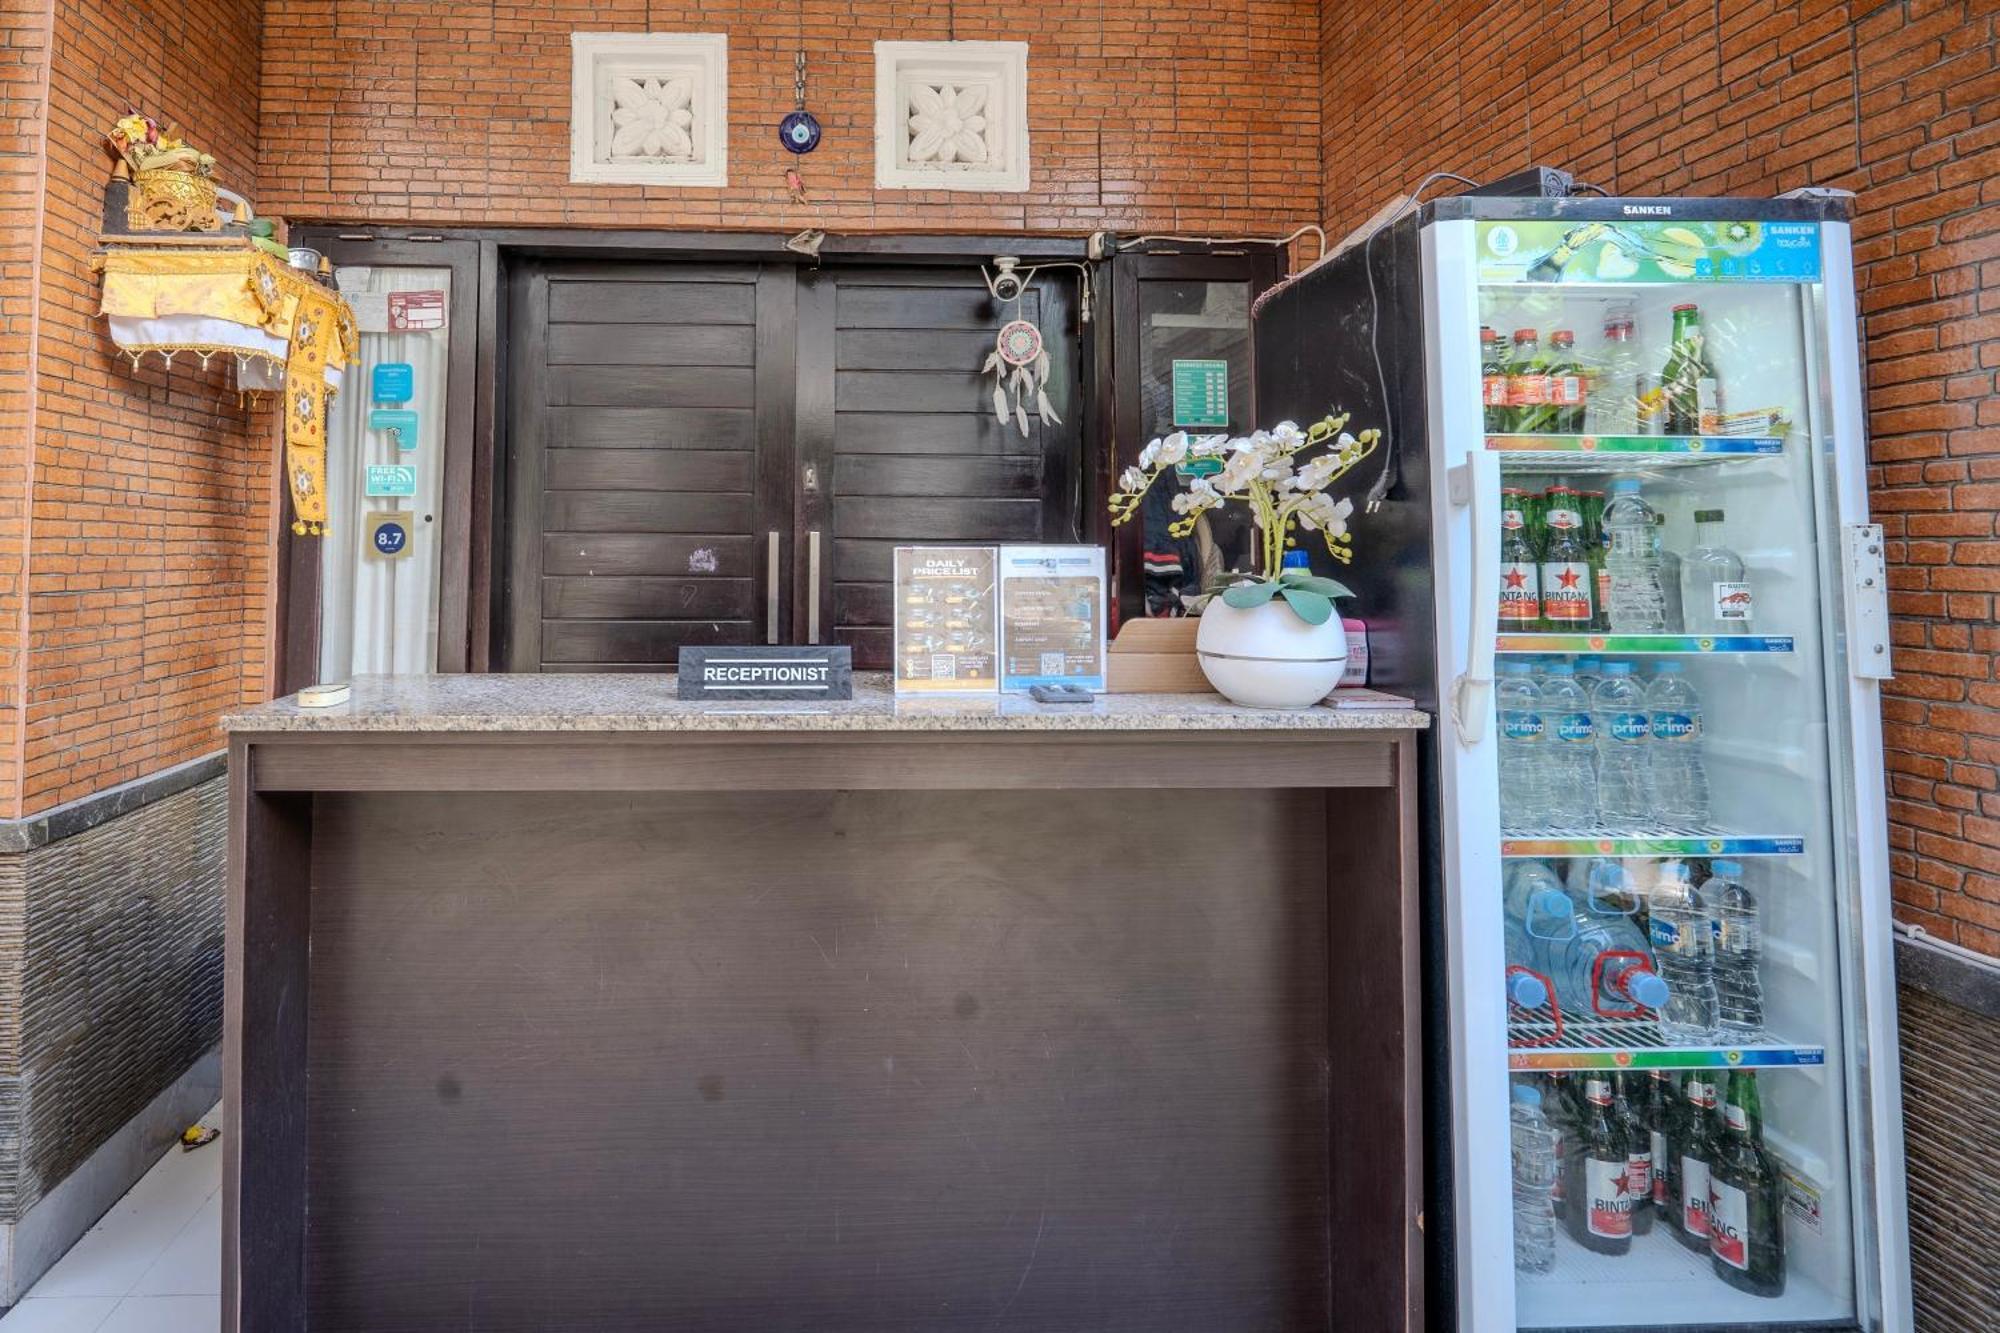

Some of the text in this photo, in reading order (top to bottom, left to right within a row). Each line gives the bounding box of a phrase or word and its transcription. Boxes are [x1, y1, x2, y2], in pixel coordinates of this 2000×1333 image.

[1623, 204, 1672, 215] SANKEN
[1770, 225, 1815, 235] SANKEN
[371, 467, 396, 475] FREE
[378, 532, 402, 545] 8.7
[926, 559, 965, 568] DAILY
[703, 667, 829, 681] RECEPTIONIST
